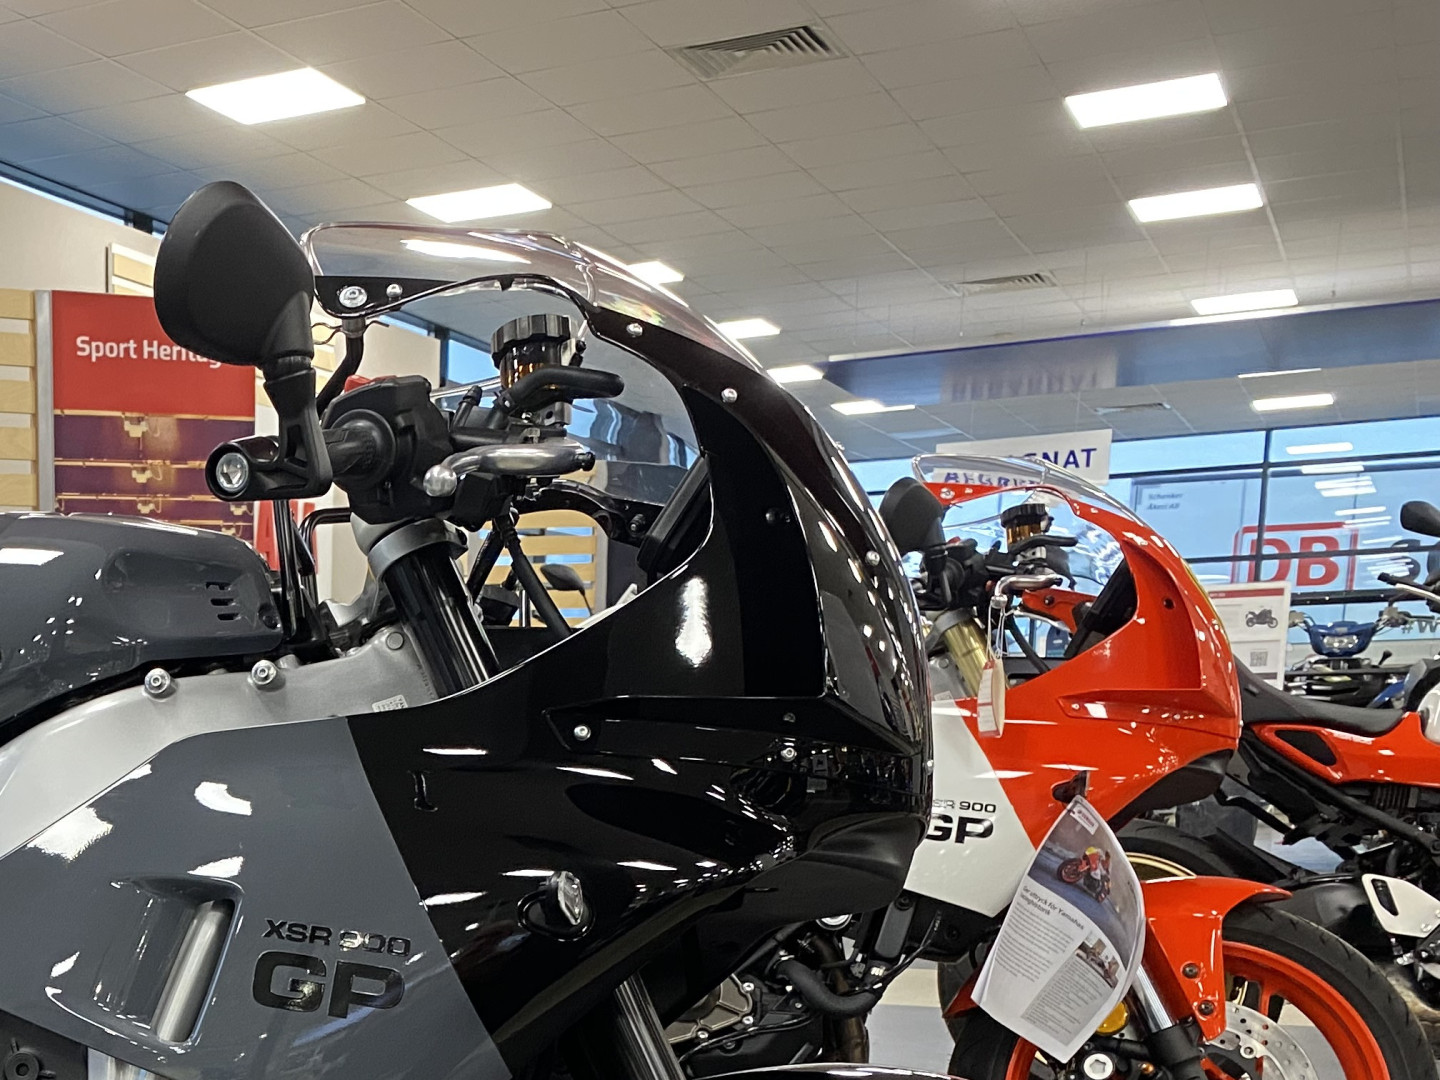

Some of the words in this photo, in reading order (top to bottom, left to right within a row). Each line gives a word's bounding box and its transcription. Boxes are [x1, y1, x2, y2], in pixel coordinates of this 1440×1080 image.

[75, 336, 137, 362] Sport
[1246, 535, 1340, 587] DB
[959, 801, 996, 813] 900
[926, 813, 994, 844] GP
[262, 918, 333, 946] XSR
[338, 929, 411, 957] 900
[252, 949, 406, 1019] GP
